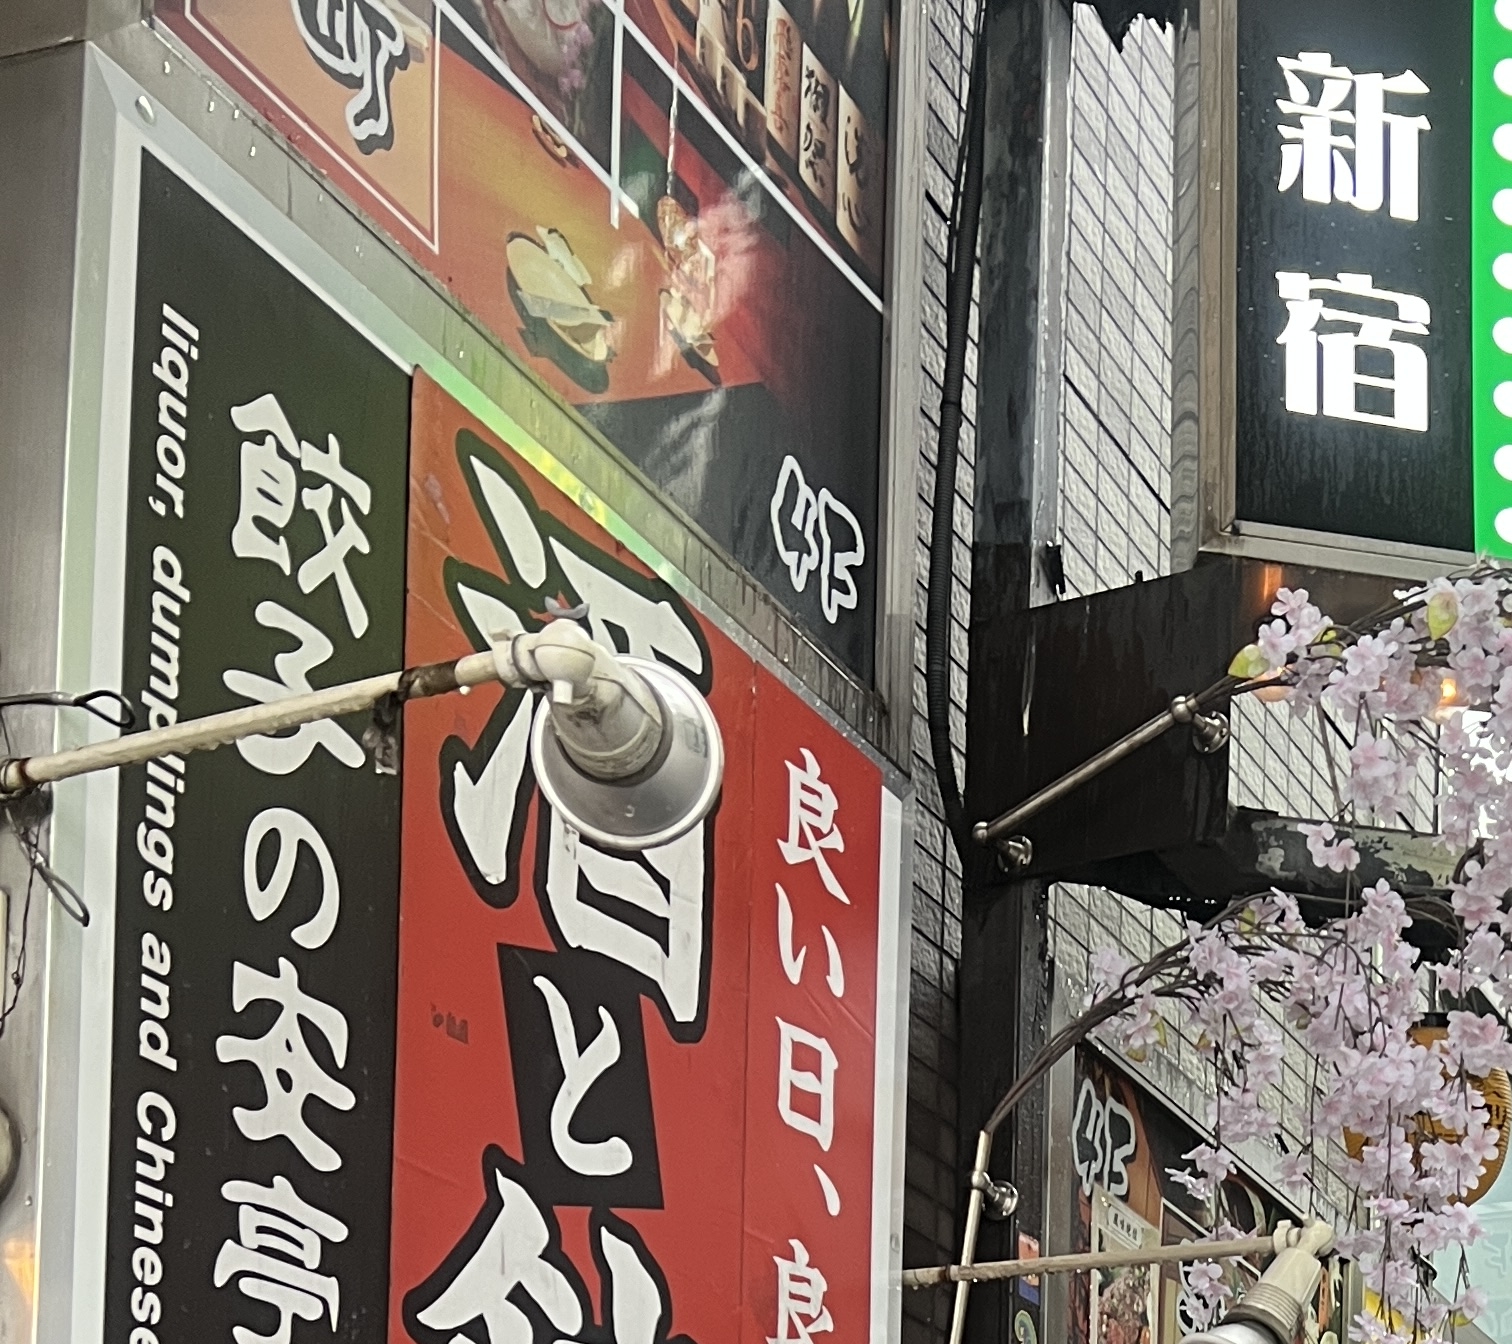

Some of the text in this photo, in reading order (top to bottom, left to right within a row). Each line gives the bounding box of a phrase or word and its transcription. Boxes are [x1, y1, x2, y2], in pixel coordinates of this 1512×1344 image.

[1275, 51, 1431, 432] 新宿
[150, 303, 201, 520] liquor,
[138, 932, 176, 1071] and
